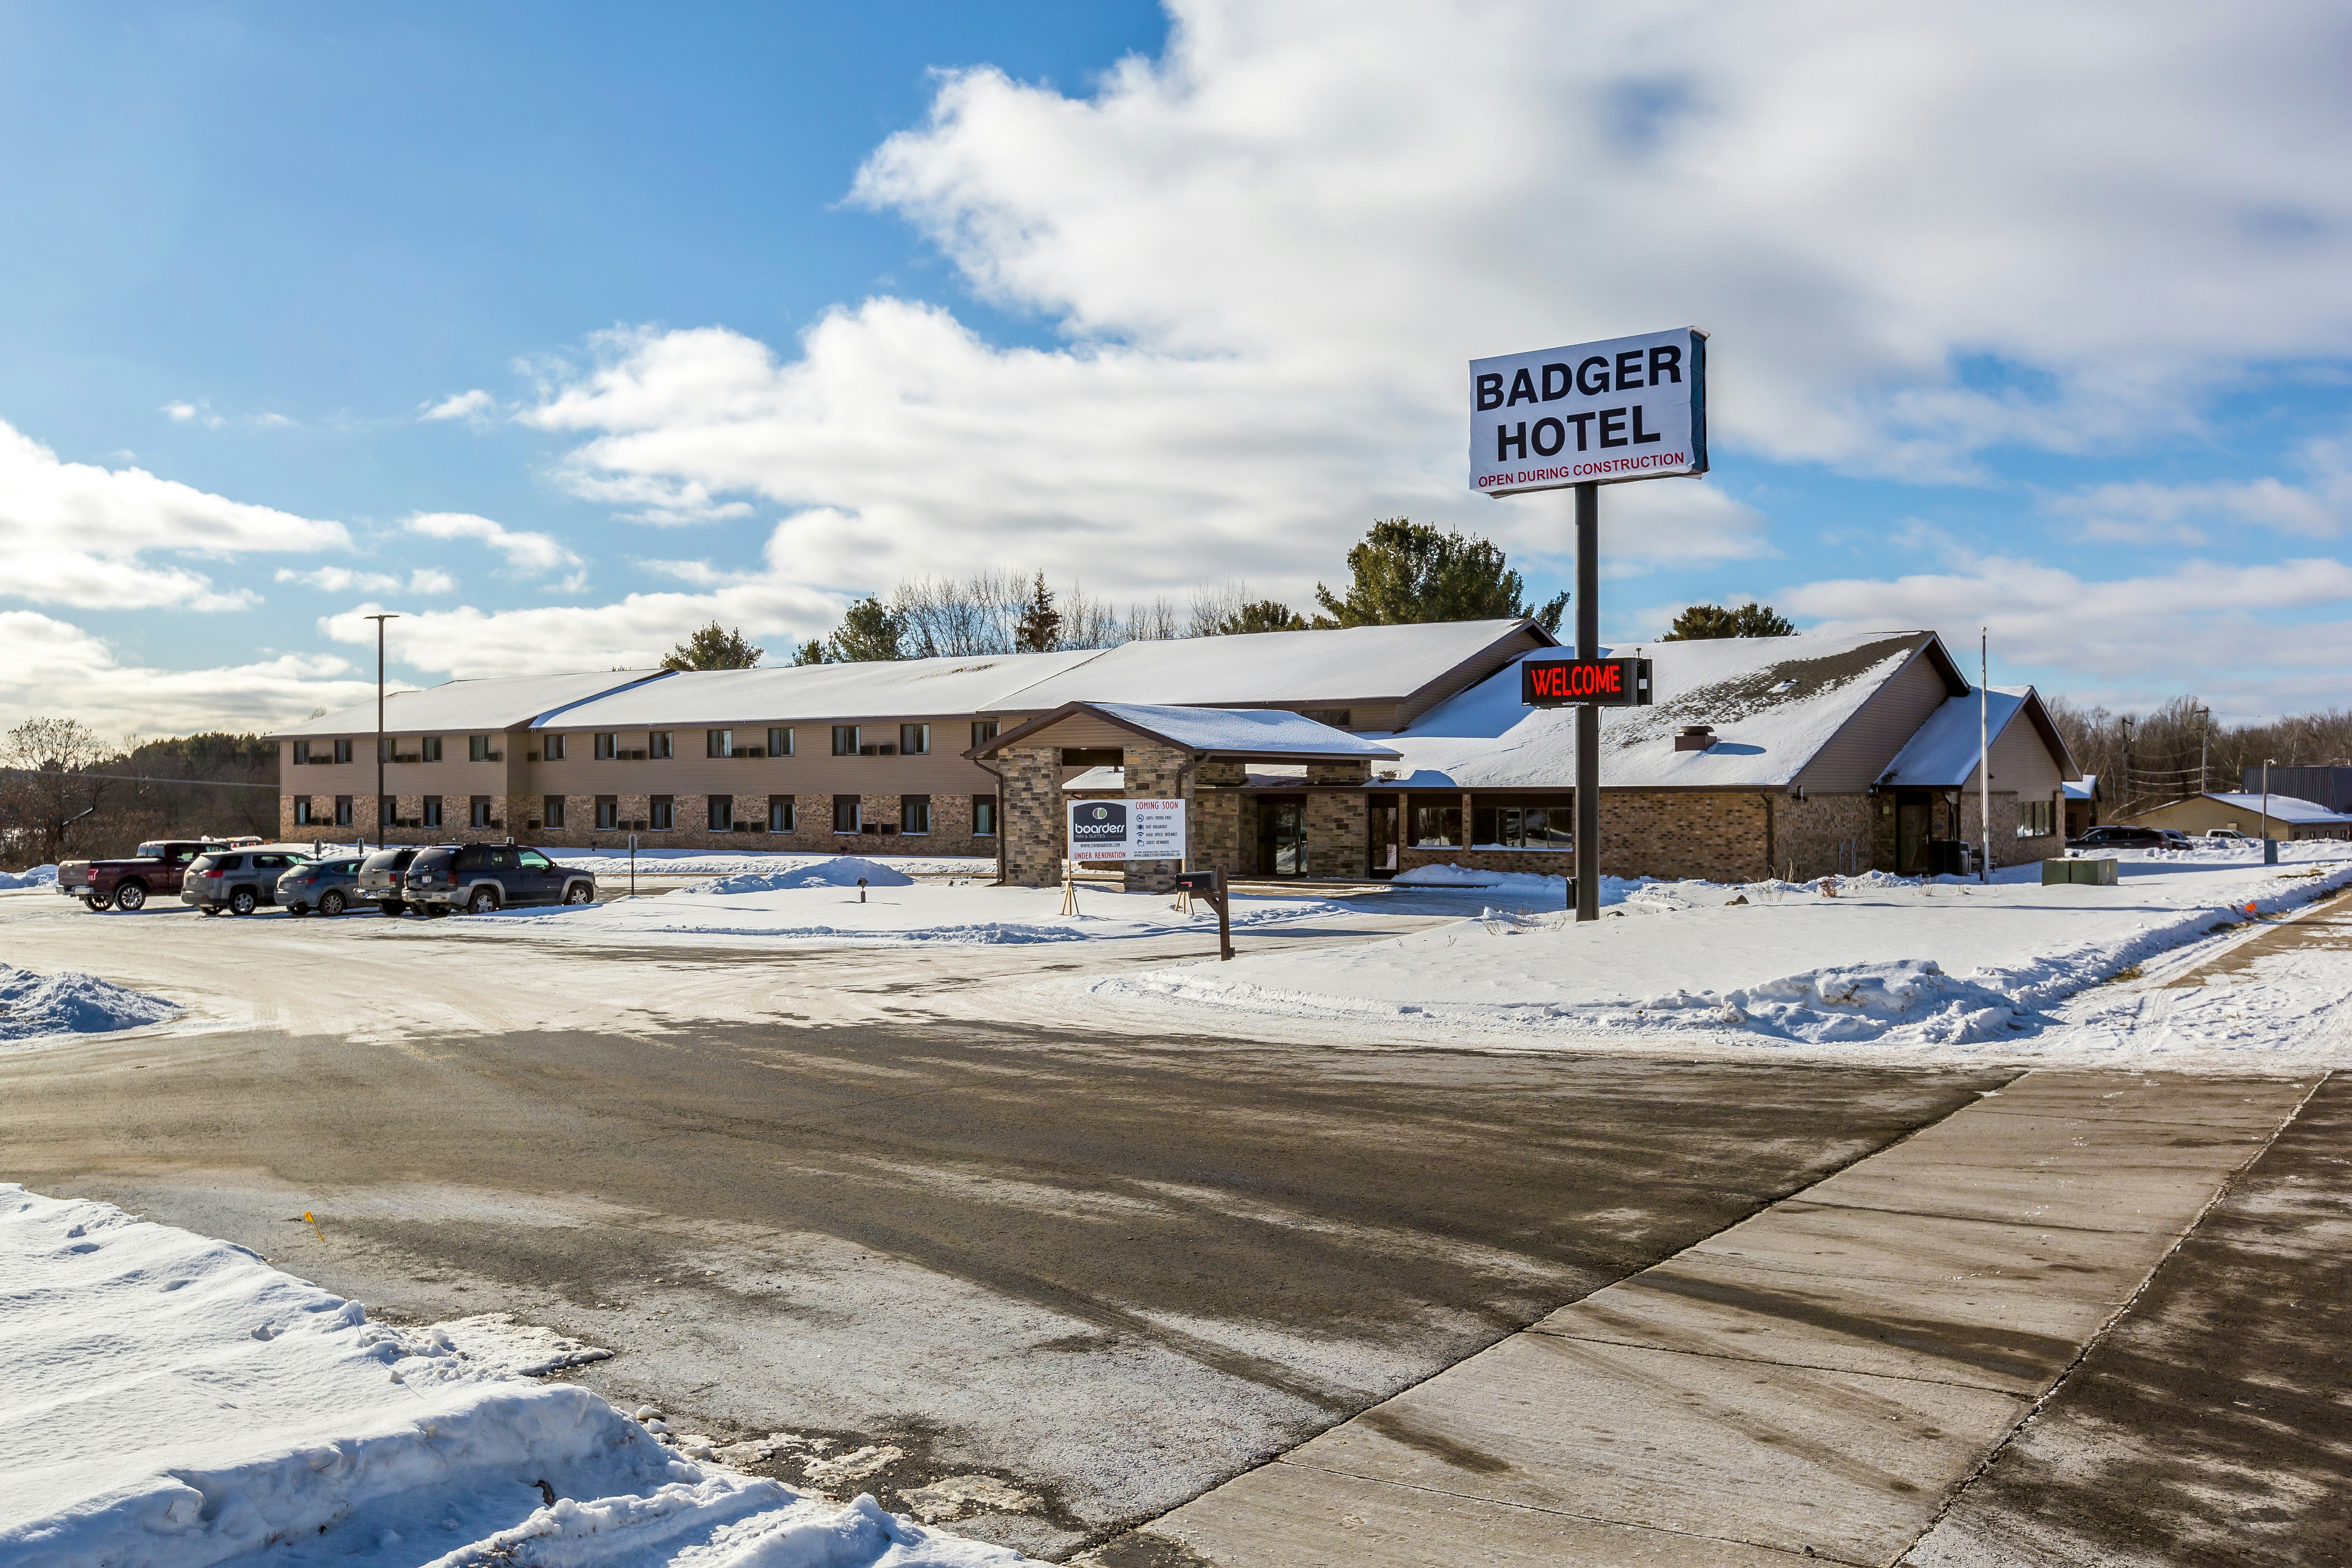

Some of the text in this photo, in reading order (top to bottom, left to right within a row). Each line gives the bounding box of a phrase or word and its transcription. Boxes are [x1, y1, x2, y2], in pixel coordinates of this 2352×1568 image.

[1477, 345, 1682, 412] BADGER
[1497, 405, 1661, 462] HOTEL
[1478, 452, 1685, 487] OPEN DURING CONSTRUCTION
[1531, 665, 1621, 696] WELCOME
[1136, 801, 1178, 810] COMING SOON
[1075, 823, 1125, 834] boarders
